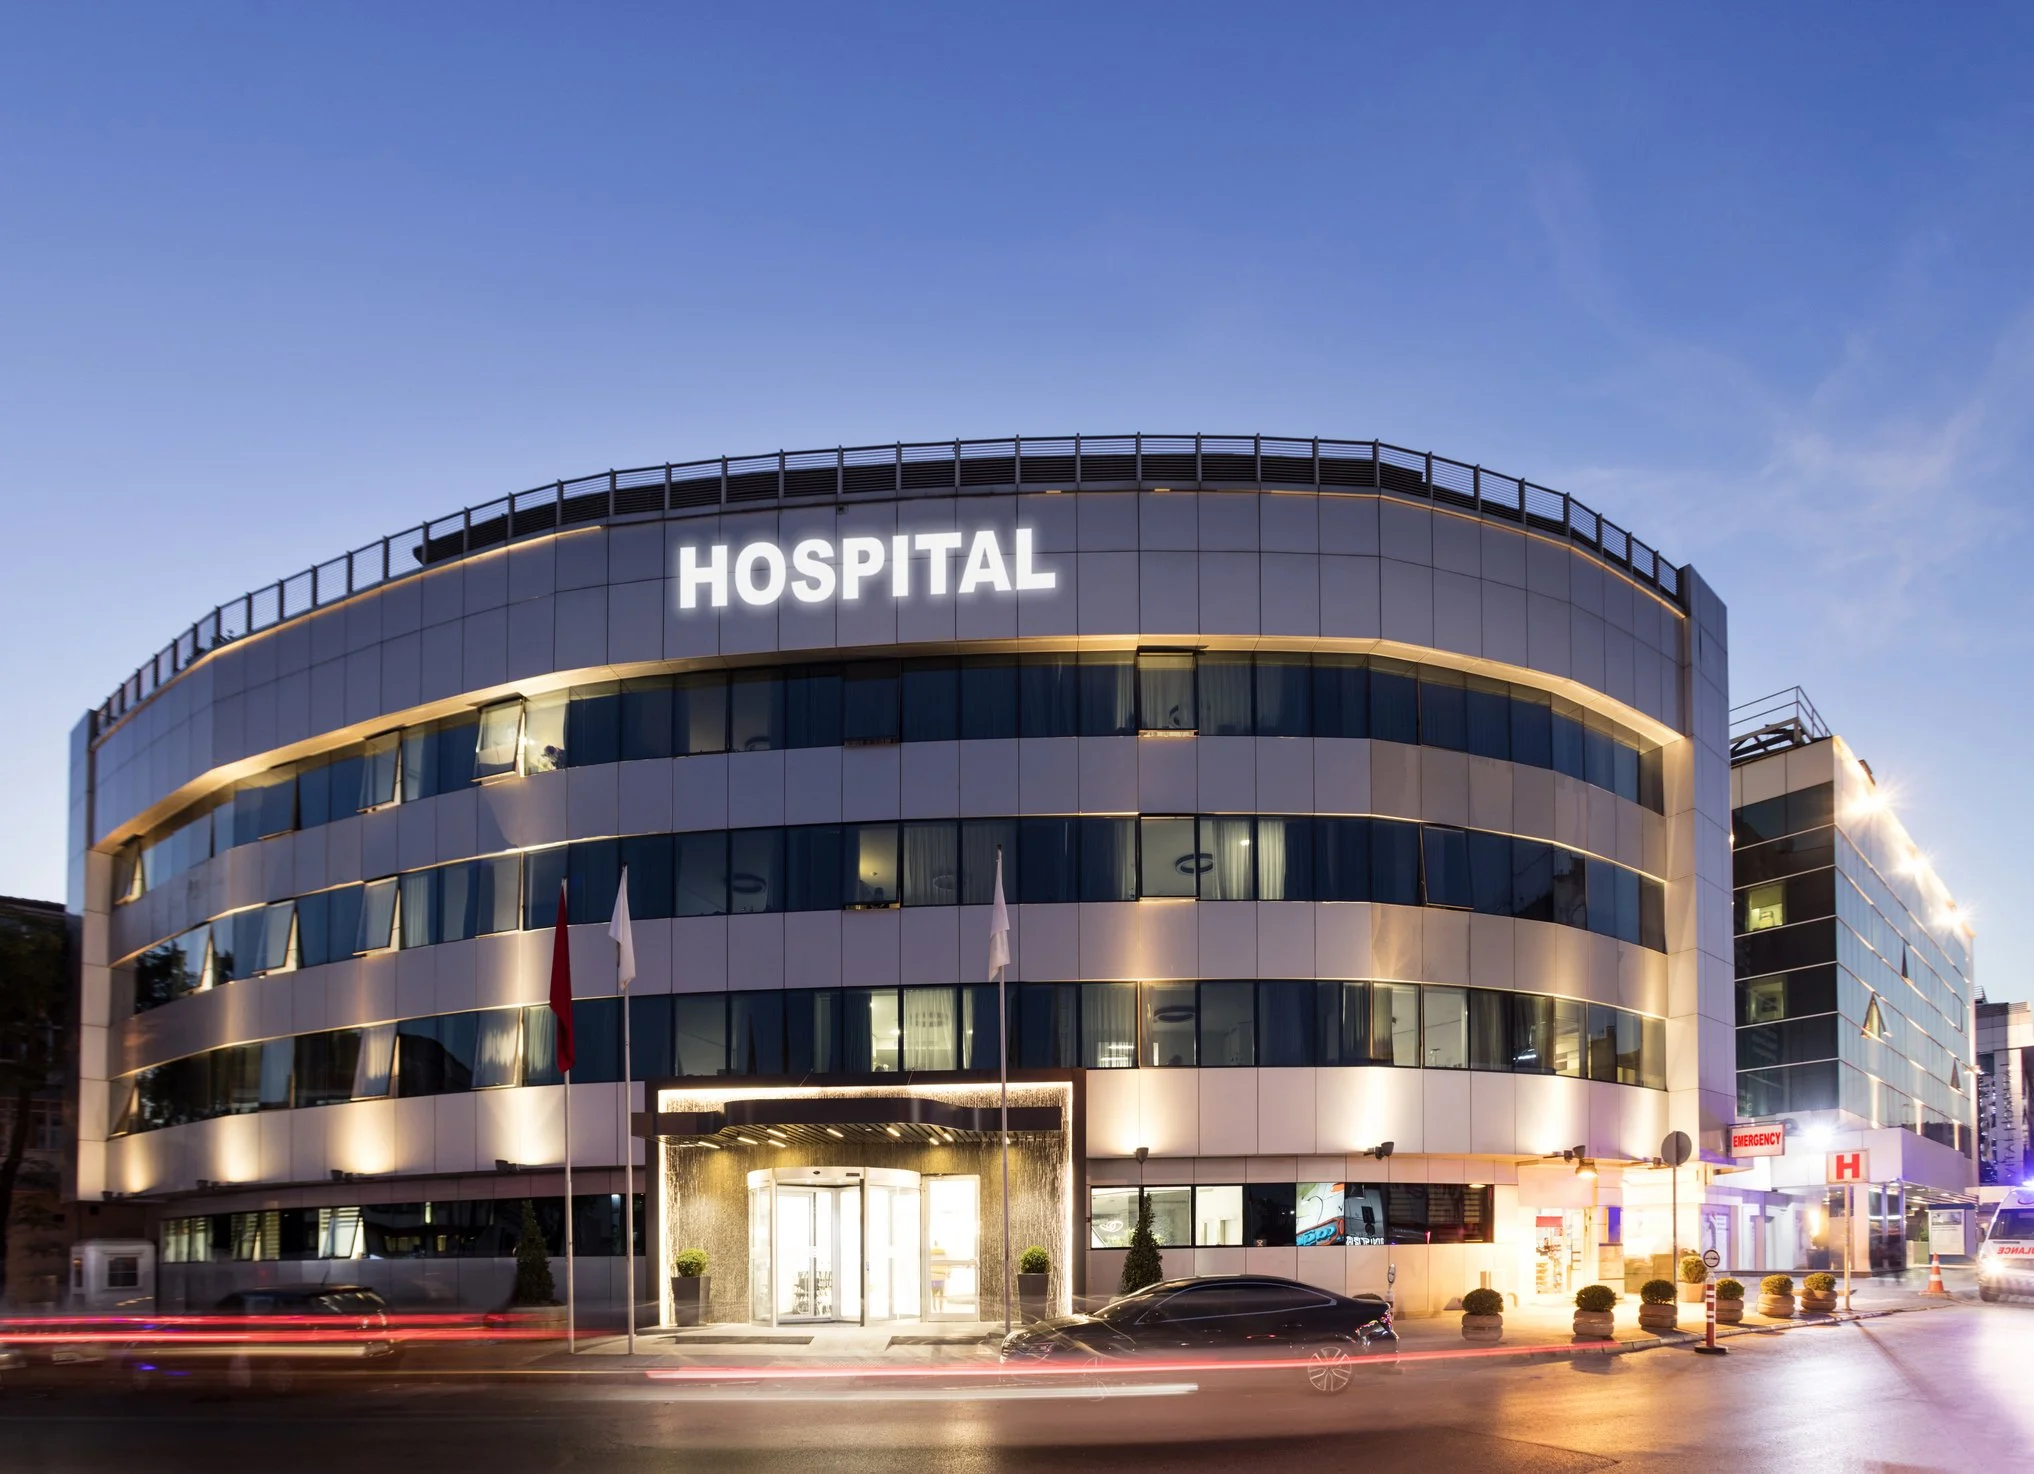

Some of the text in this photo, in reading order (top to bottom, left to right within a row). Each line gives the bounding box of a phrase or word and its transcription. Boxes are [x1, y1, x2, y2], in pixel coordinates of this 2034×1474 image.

[680, 528, 1056, 609] HOSPITAL
[1733, 1132, 1781, 1148] EMERGENCY
[1836, 1153, 1861, 1180] H
